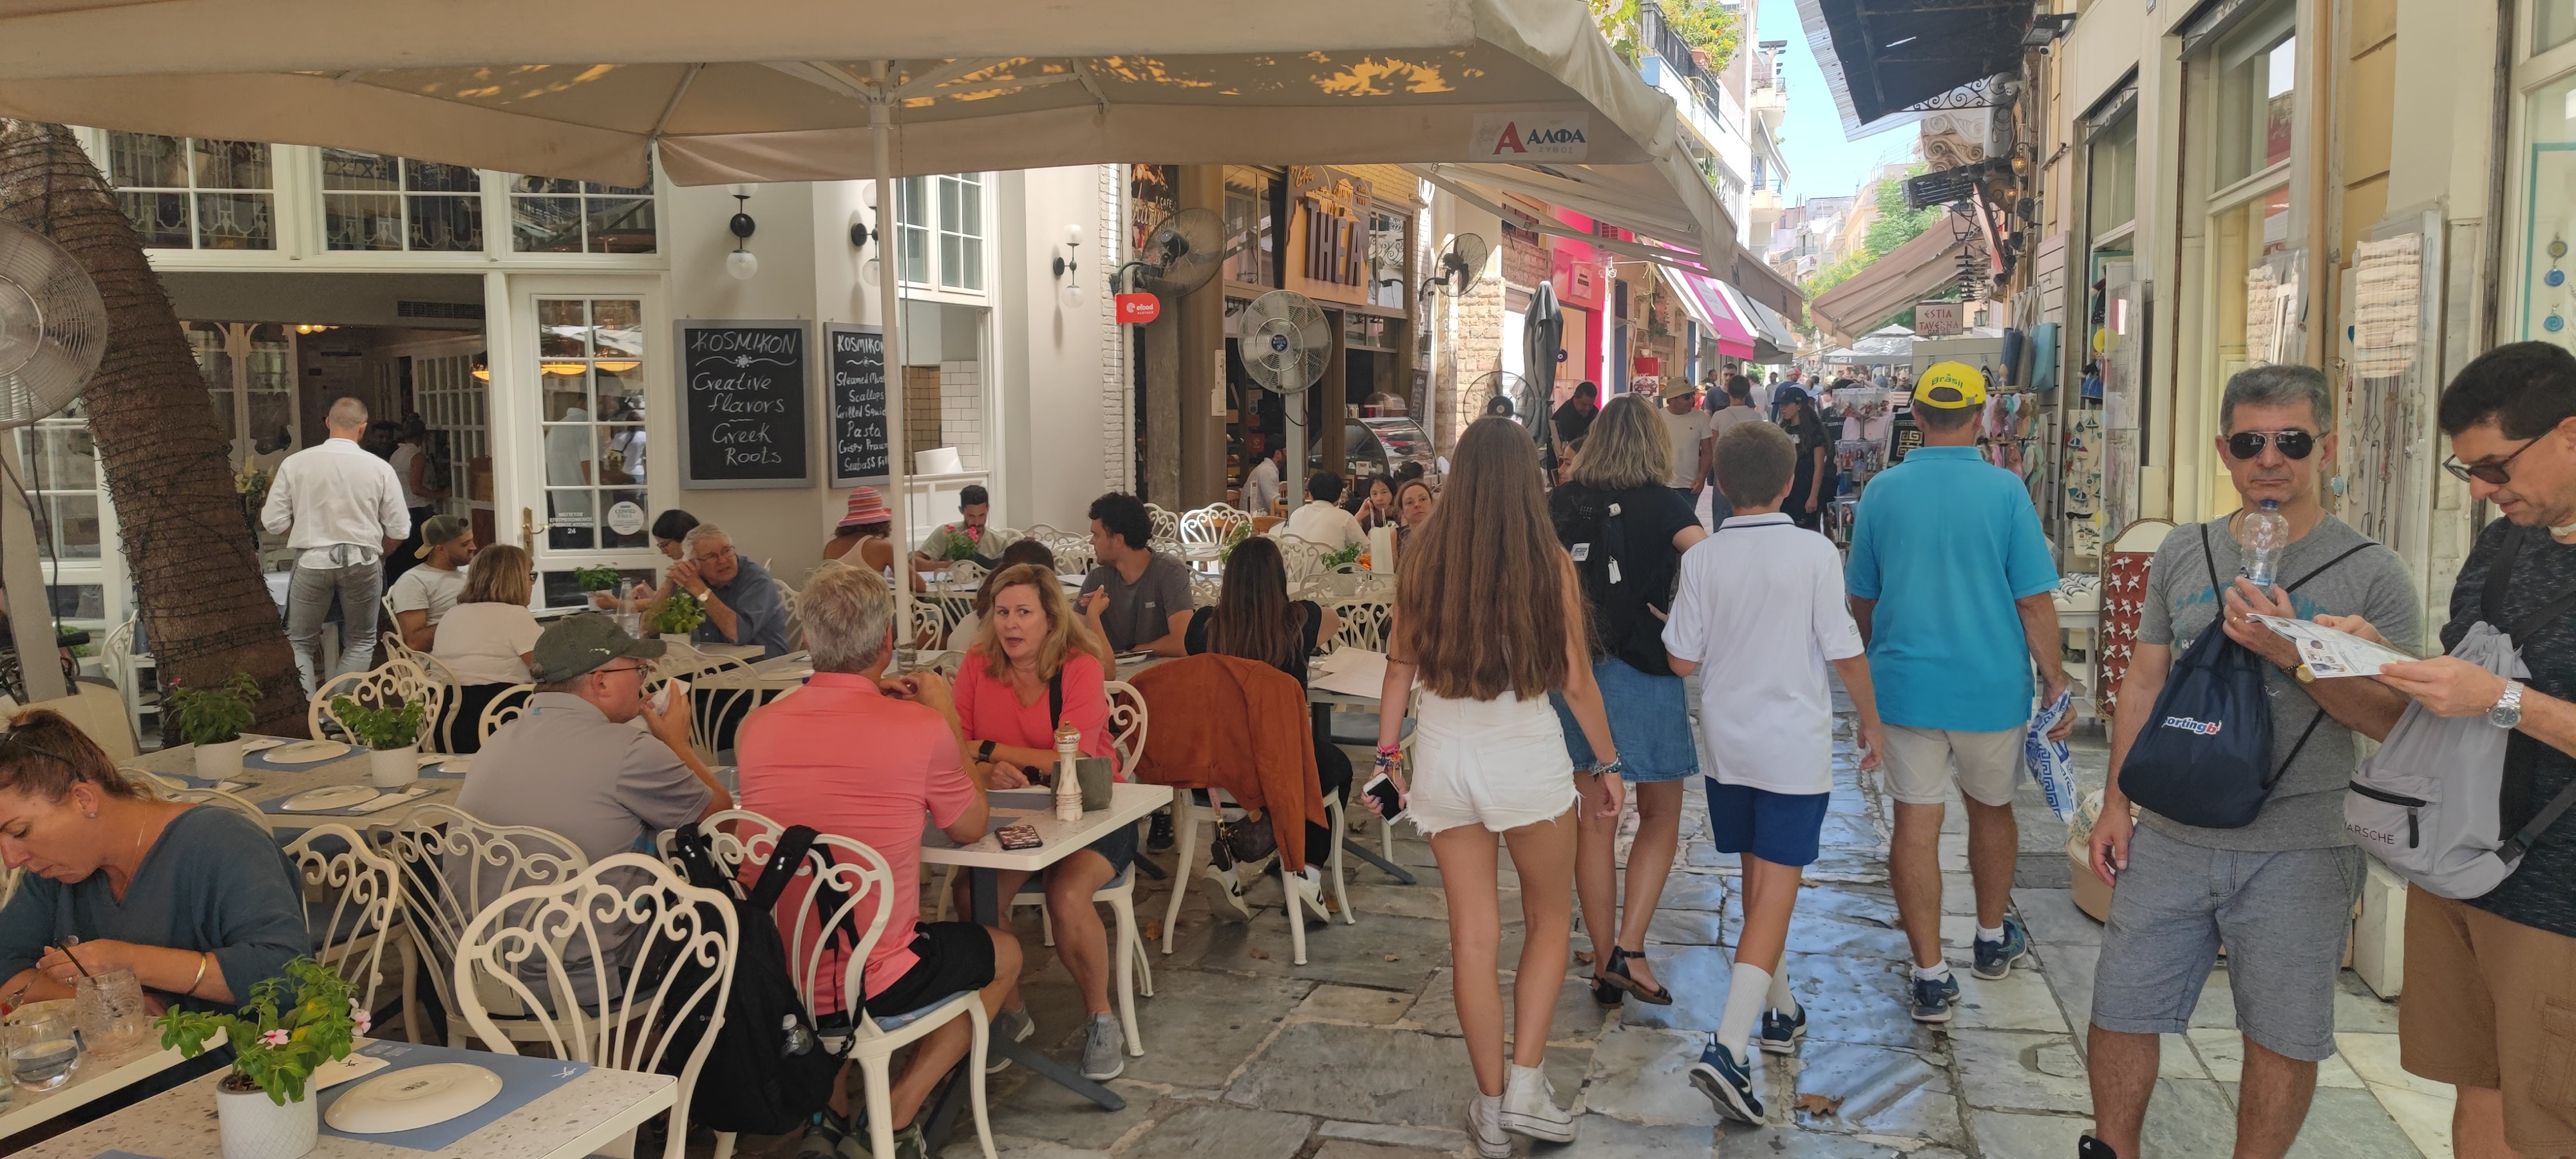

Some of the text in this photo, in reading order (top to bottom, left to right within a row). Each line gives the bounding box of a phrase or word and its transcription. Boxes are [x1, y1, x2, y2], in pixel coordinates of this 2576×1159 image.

[1305, 197, 1361, 287] THEA
[1924, 309, 1952, 318] ESTIA
[691, 331, 797, 354] KOSMIKON
[693, 372, 772, 390] Creative
[837, 372, 868, 386] Steamed
[1931, 377, 1963, 388] Brasil
[708, 393, 784, 413] flavors
[849, 389, 884, 402] Scallops
[837, 404, 863, 419] Grilled
[712, 422, 772, 444] Greek
[846, 420, 882, 437] Pasta
[725, 446, 782, 466] Roots
